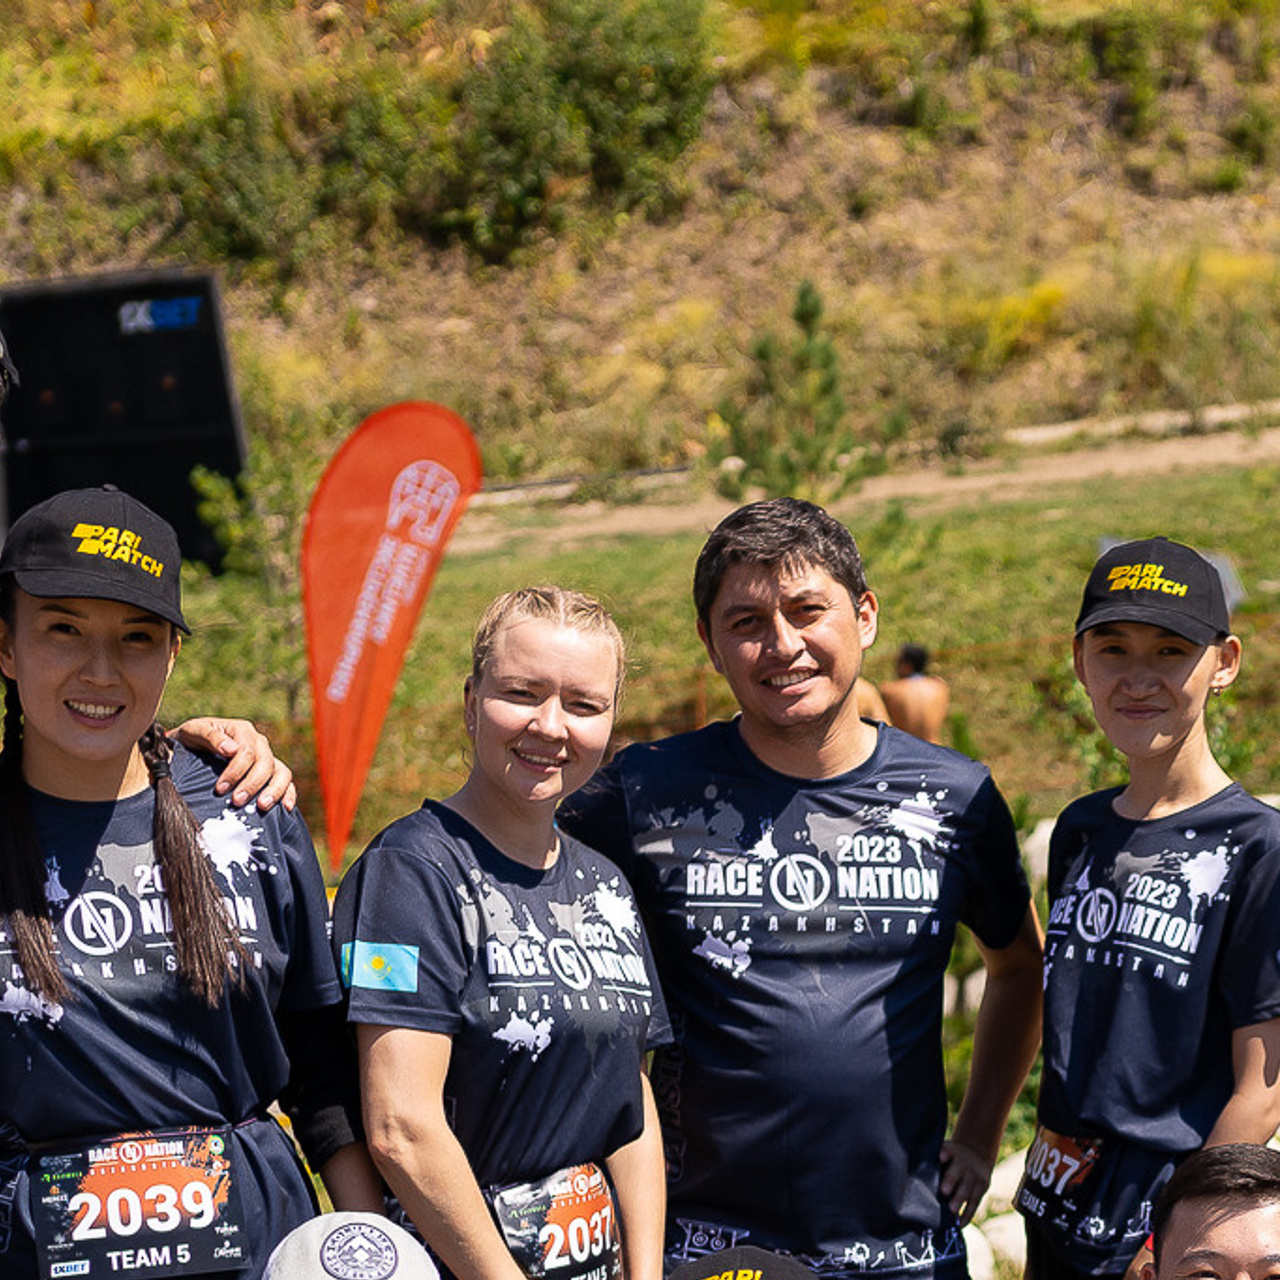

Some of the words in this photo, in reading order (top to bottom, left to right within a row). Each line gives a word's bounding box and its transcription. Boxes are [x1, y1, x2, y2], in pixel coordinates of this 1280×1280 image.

[71, 523, 142, 549] PARI
[76, 538, 164, 578] MATCH
[1107, 563, 1164, 581] PARI
[1109, 577, 1188, 597] MATCH
[836, 834, 902, 863] 2023
[687, 863, 763, 896] RACE
[837, 867, 940, 901] NATION
[1124, 873, 1181, 910] 2023
[575, 923, 617, 950] 2023
[686, 914, 940, 936] KAZAKHSTAN
[1116, 902, 1204, 954] NATION
[486, 941, 550, 977] RACE
[586, 950, 651, 986] NATION
[144, 1141, 184, 1157] NATION
[67, 1181, 215, 1241] 2039
[538, 1206, 611, 1271] 2037
[106, 1247, 171, 1271] TEAM
[176, 1244, 191, 1264] 5
